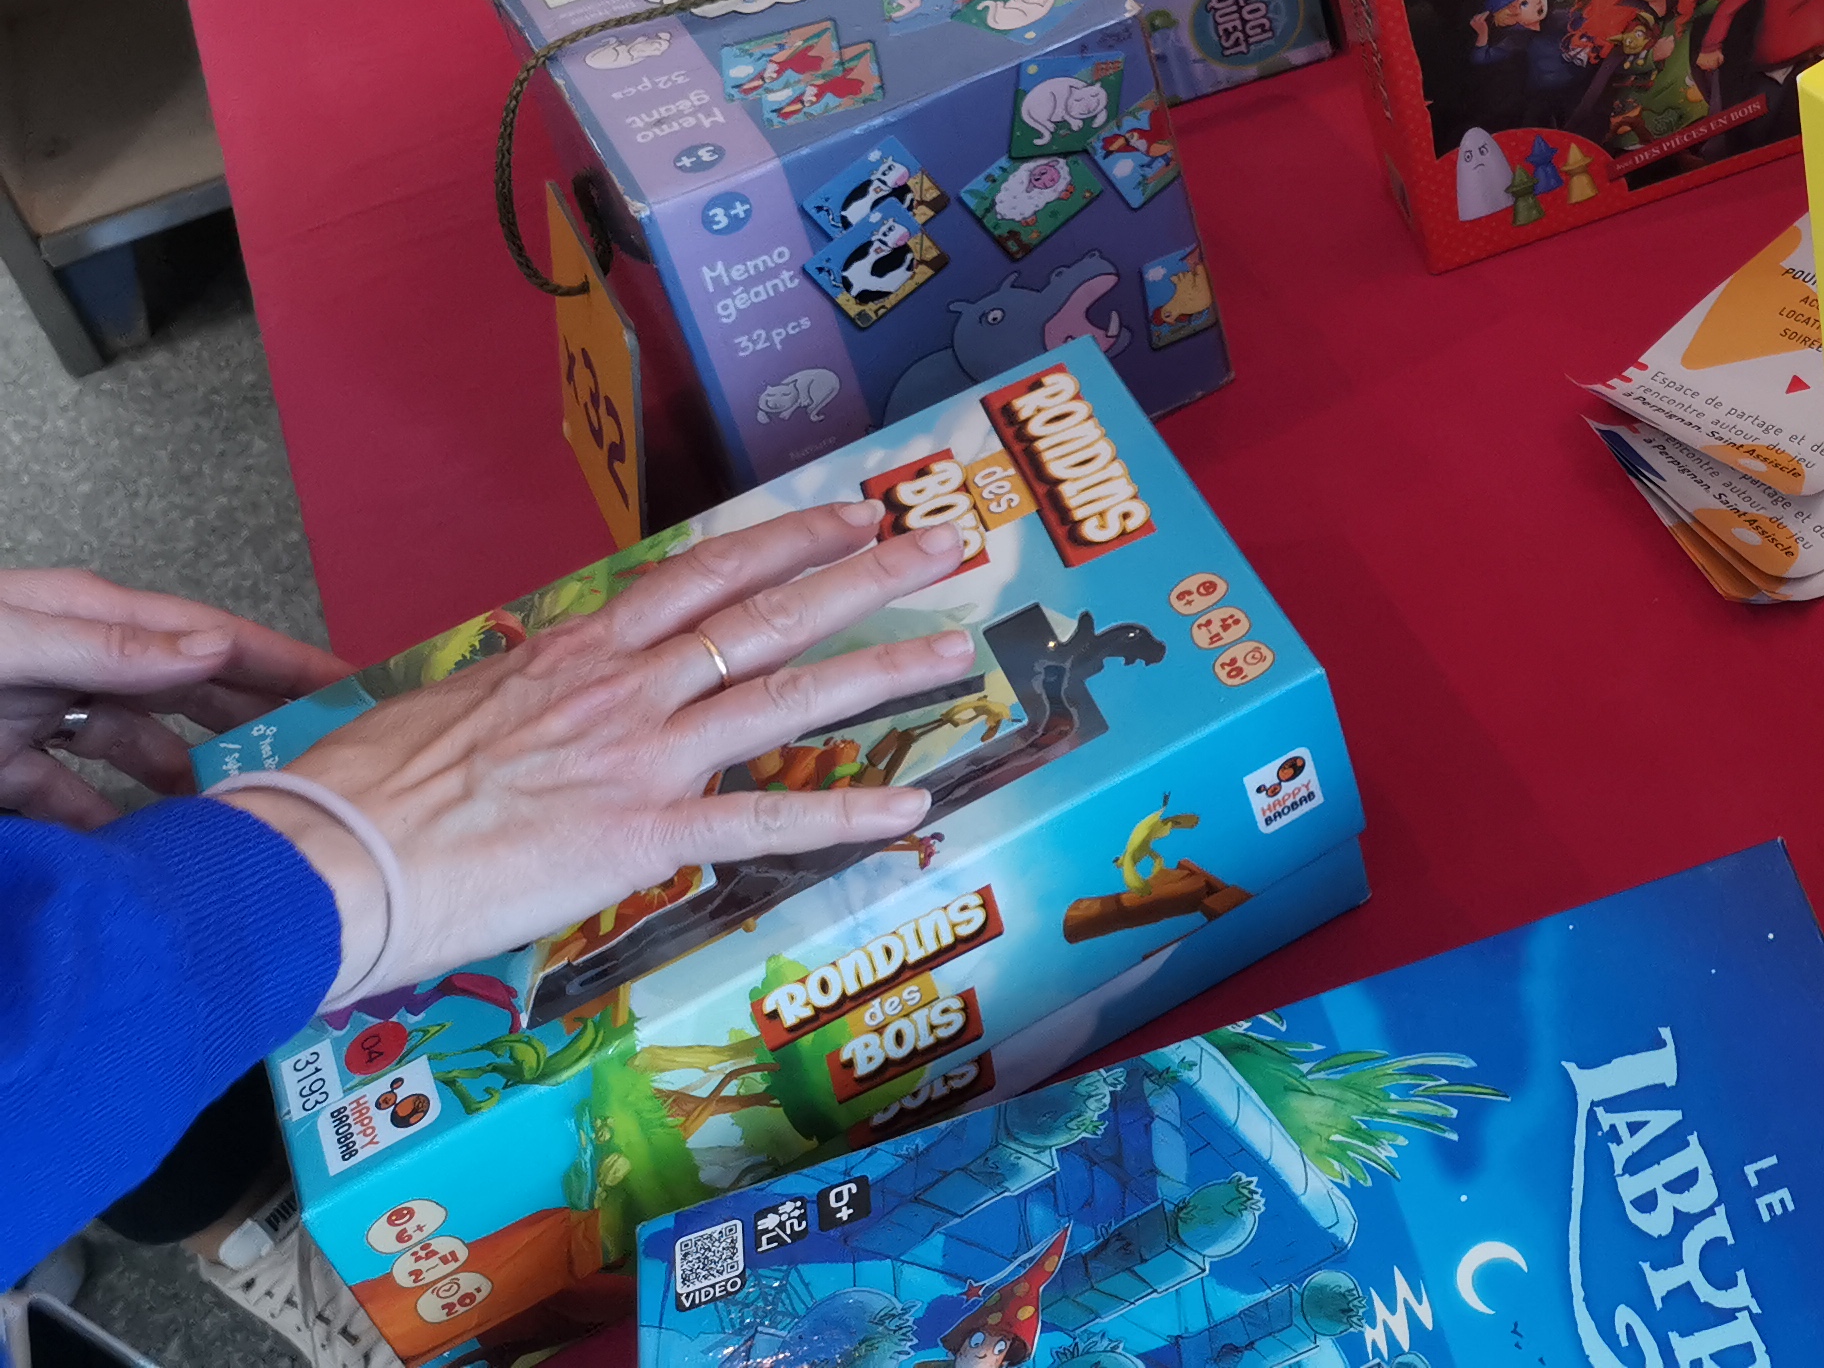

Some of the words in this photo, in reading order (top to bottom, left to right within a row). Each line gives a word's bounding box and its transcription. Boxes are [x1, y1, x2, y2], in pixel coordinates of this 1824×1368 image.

[636, 107, 727, 143] Memo
[1731, 101, 1762, 123] BOIS
[676, 146, 719, 168] 3+
[708, 200, 751, 231] 3+
[700, 245, 791, 293] Memo
[715, 269, 801, 324] géant
[1622, 389, 1634, 401] à
[1706, 429, 1744, 454] Saint
[1743, 446, 1805, 480] Assiscle
[1636, 382, 1706, 420] rencontre
[1711, 416, 1760, 444] autour
[1767, 439, 1786, 457] du
[1792, 450, 1816, 471] jeu
[1651, 370, 1700, 400] Espace
[1705, 394, 1723, 413] de
[1728, 403, 1784, 438] partage
[1789, 429, 1805, 446] et
[1012, 371, 1152, 544] RONDINS
[973, 466, 1021, 514] des
[1642, 435, 1653, 446] à
[1712, 490, 1747, 519] Saint
[1746, 514, 1796, 560] Assiscle
[1722, 478, 1766, 513] autour
[1769, 511, 1788, 530] du
[1789, 527, 1814, 552] jeu
[1795, 507, 1812, 524] et
[1261, 779, 1312, 817] HAPPY
[1264, 790, 1316, 827] BAOBAB
[762, 891, 988, 1030] RONDINS
[864, 984, 923, 1028] des
[360, 1034, 384, 1063] 04
[840, 993, 967, 1080] BOIS
[292, 1051, 331, 1113] 3193
[329, 1105, 359, 1163] BAOBAB
[348, 1093, 381, 1150] HAPPY
[1743, 1154, 1796, 1224] LE
[681, 1276, 743, 1310] VIDEO
